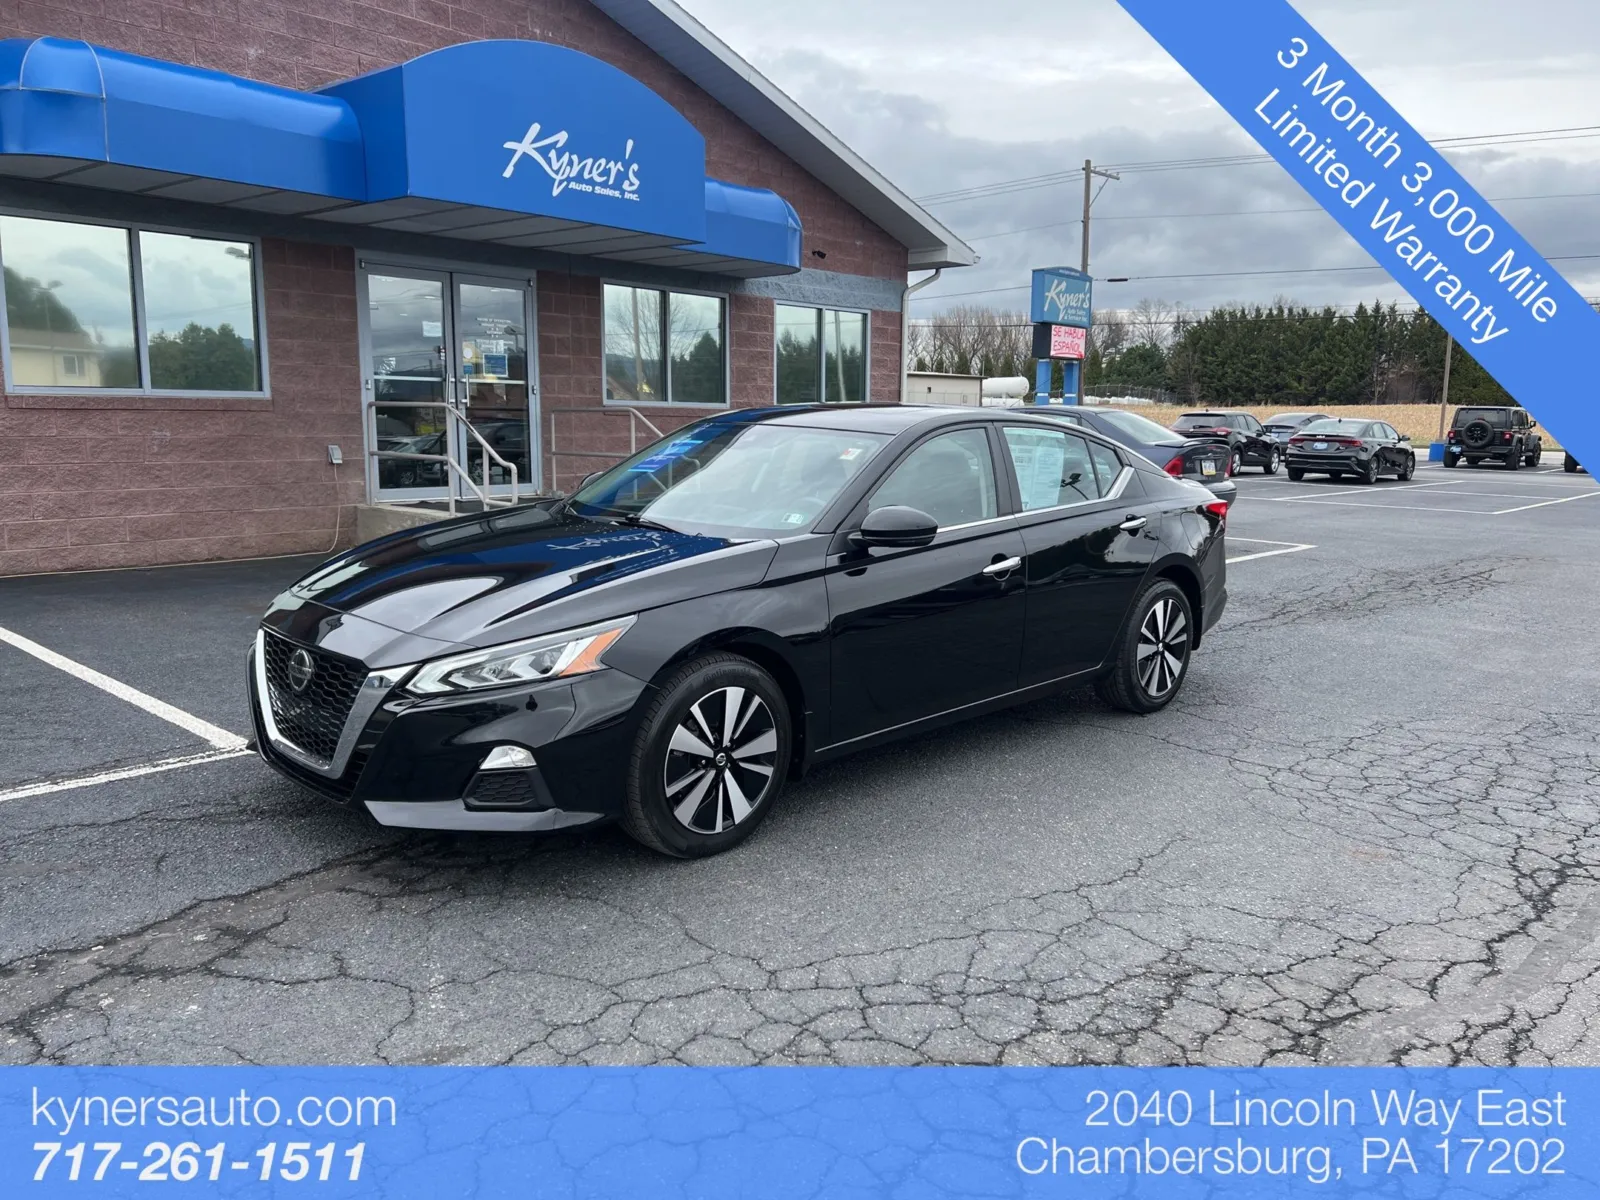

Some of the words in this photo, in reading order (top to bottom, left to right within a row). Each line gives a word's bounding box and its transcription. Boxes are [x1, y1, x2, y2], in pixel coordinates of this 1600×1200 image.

[502, 122, 640, 197] Kyner's
[568, 181, 593, 193] Auto
[594, 185, 622, 198] Sales,
[624, 191, 640, 201] Inc.
[1045, 279, 1089, 321] Kyner's
[1053, 326, 1062, 337] SE
[1063, 328, 1085, 340] HABLA
